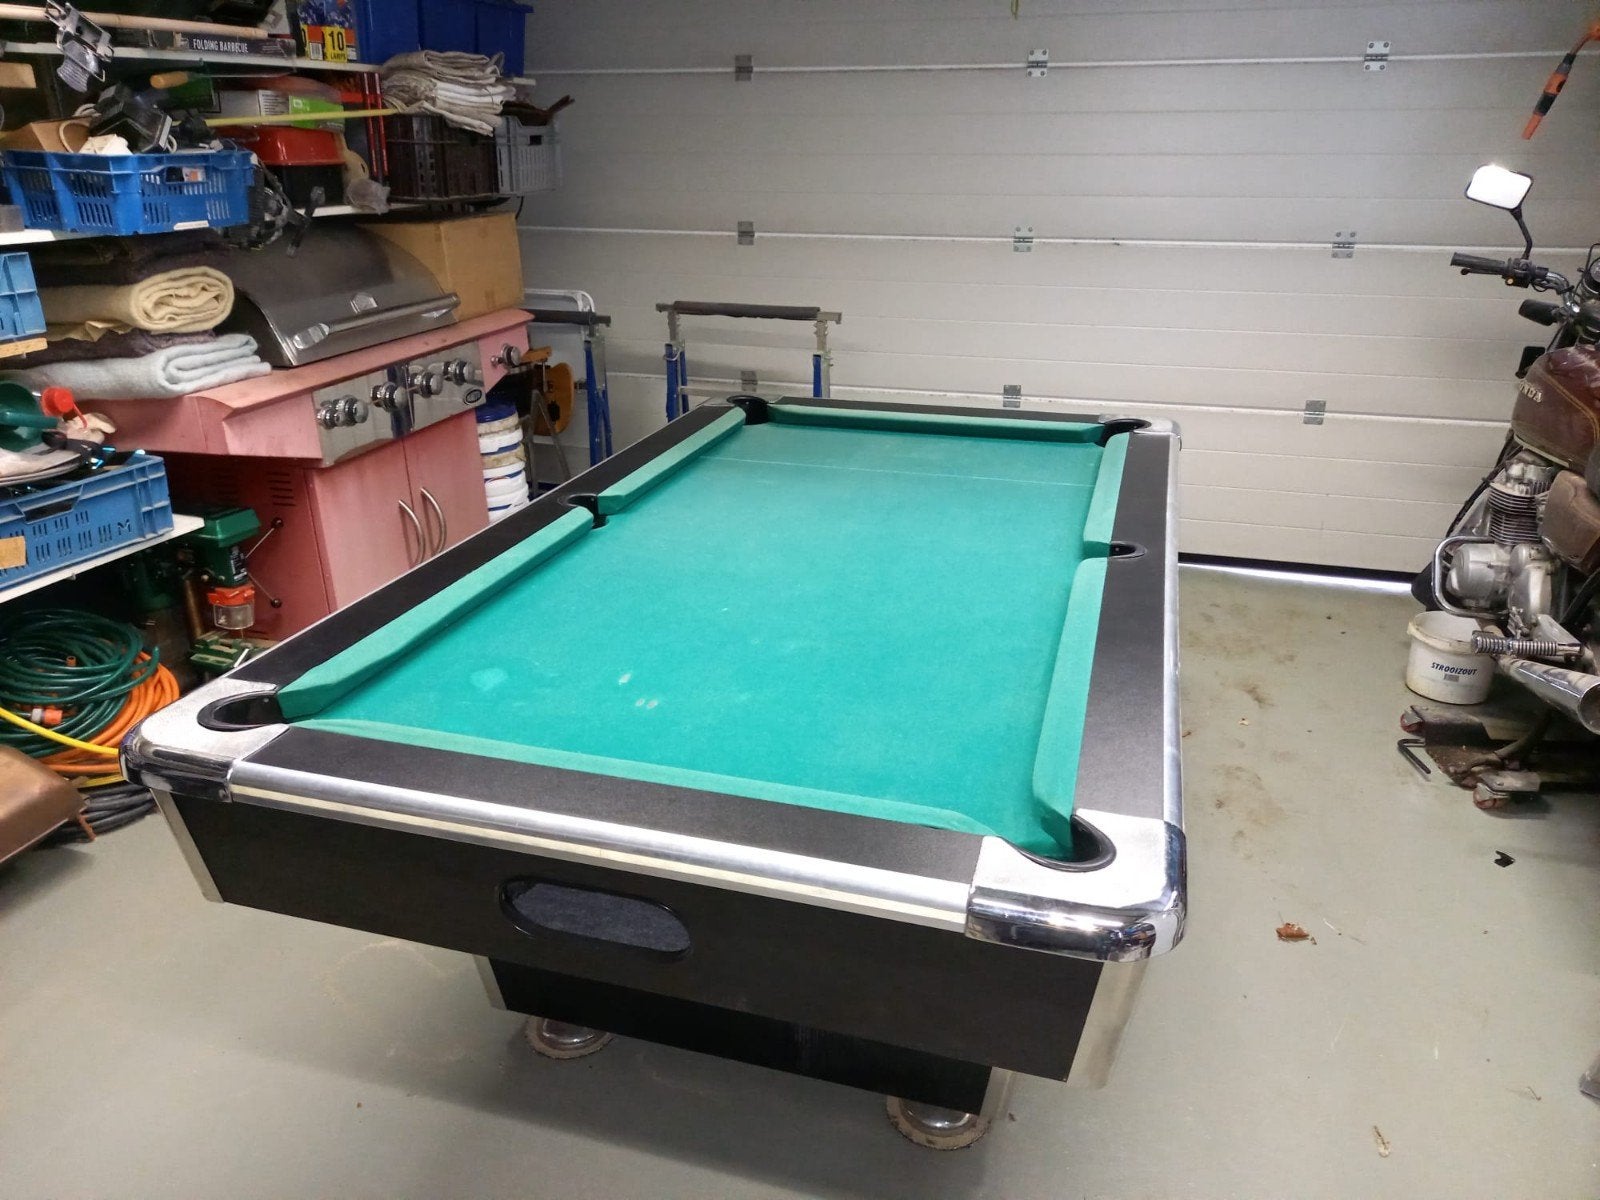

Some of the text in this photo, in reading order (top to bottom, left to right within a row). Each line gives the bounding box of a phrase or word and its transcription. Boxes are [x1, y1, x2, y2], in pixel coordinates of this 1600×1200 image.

[193, 38, 219, 51] FOLDING
[219, 41, 249, 53] BARBECUE
[328, 30, 345, 51] 10
[1431, 662, 1477, 675] STROOIZOUT
